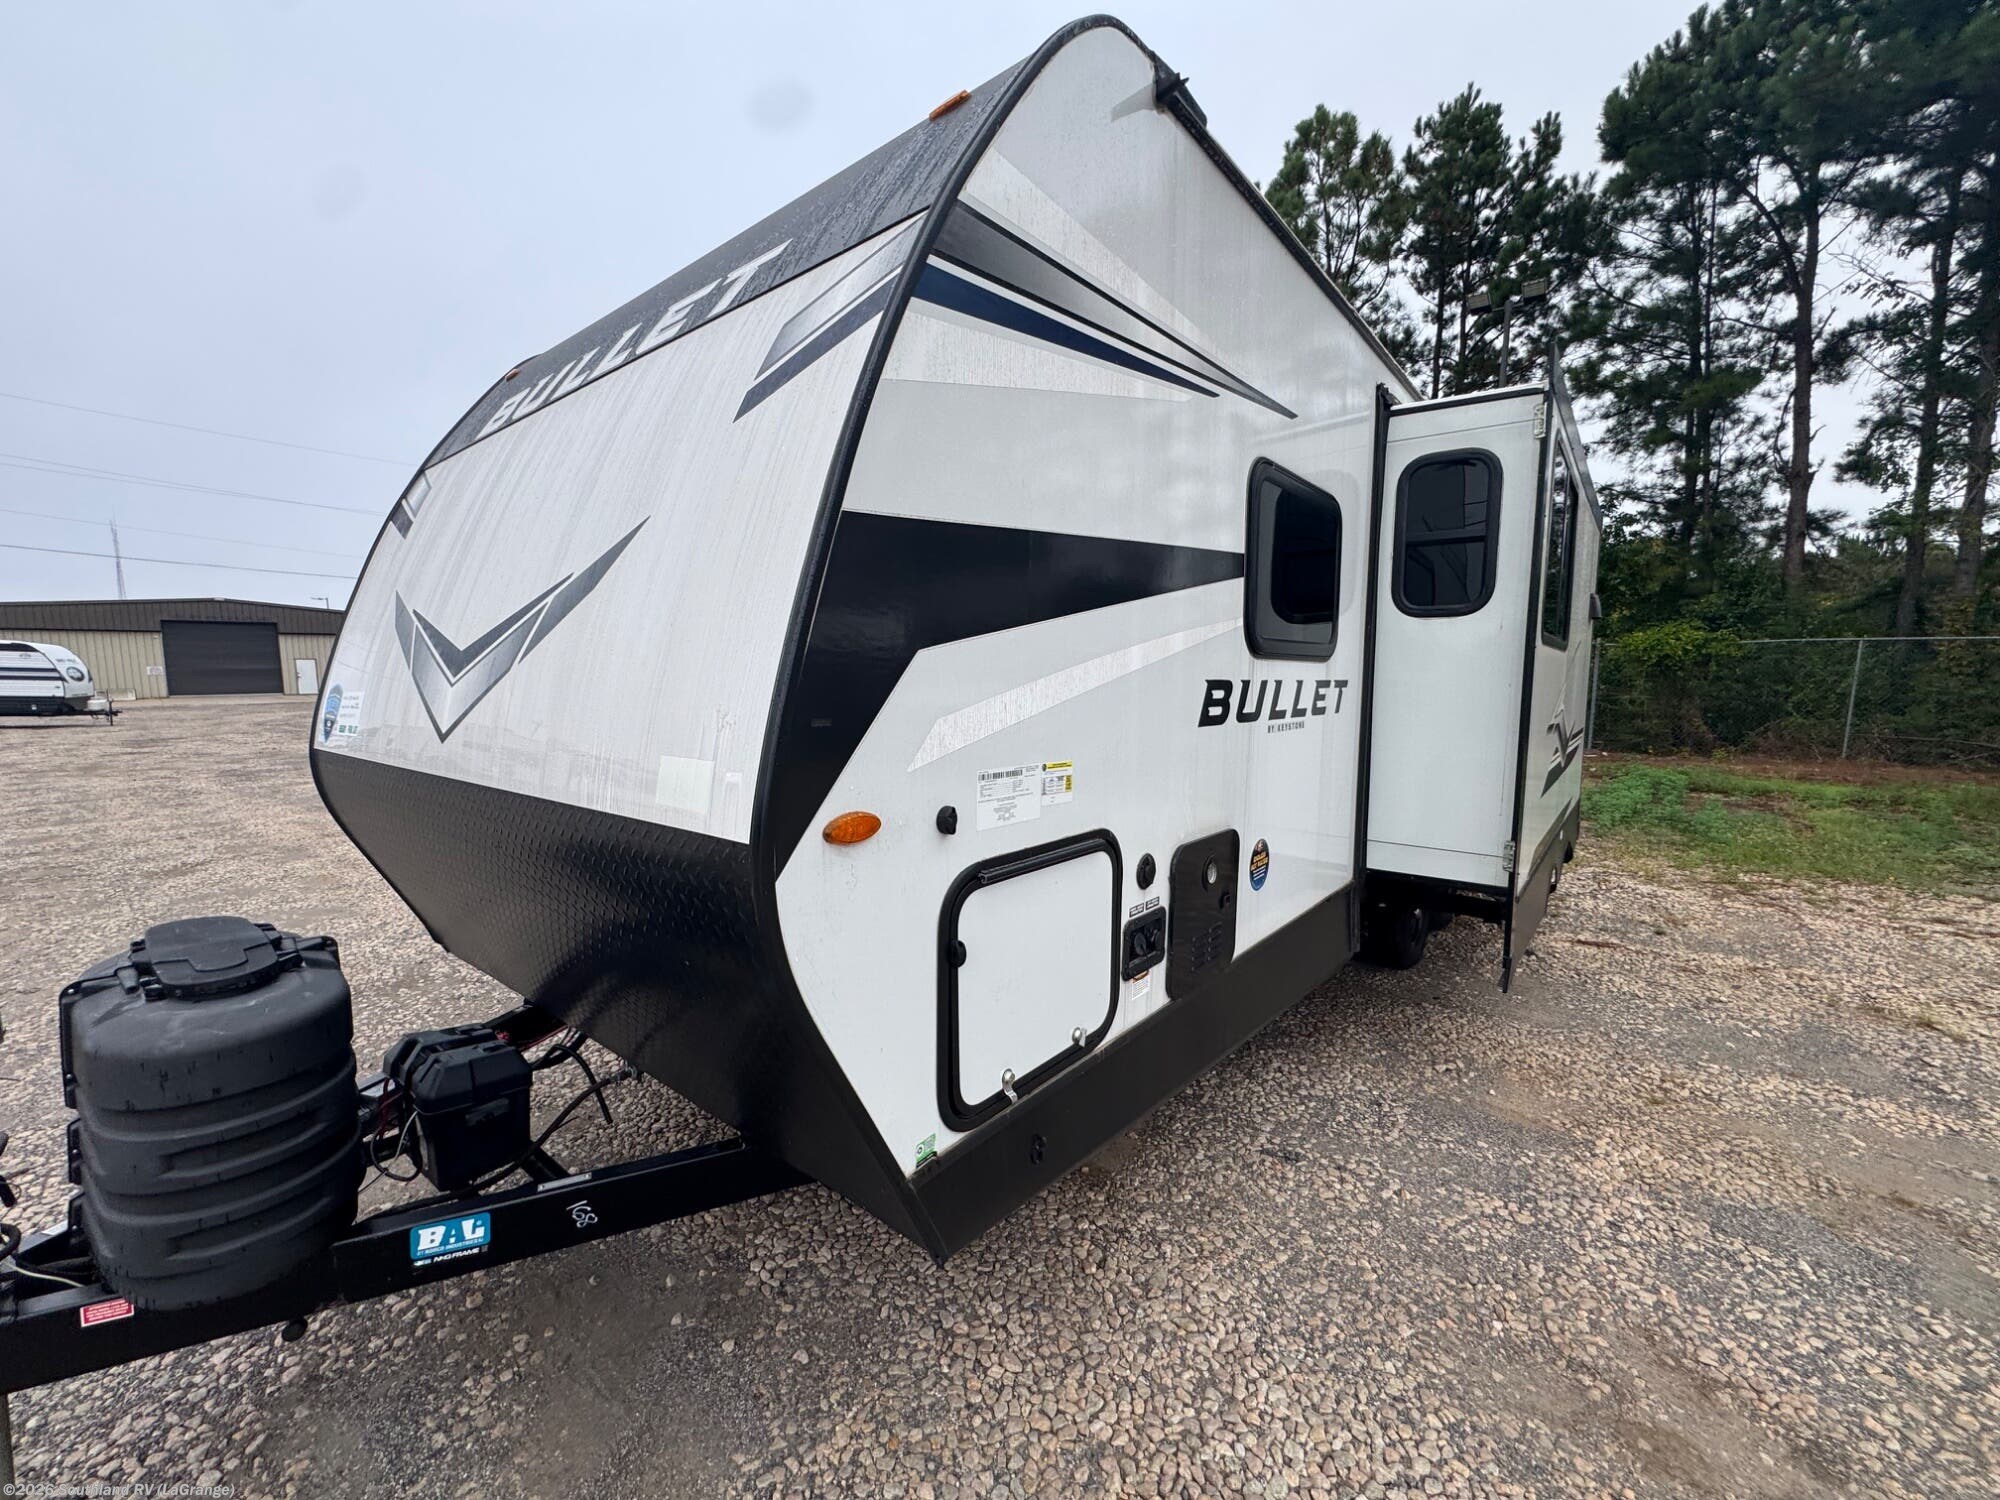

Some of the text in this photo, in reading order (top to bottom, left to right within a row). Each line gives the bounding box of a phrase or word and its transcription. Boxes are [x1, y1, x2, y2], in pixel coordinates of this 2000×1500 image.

[474, 238, 793, 441] BULLET
[1198, 679, 1349, 728] BULLET
[417, 1218, 485, 1251] BAL
